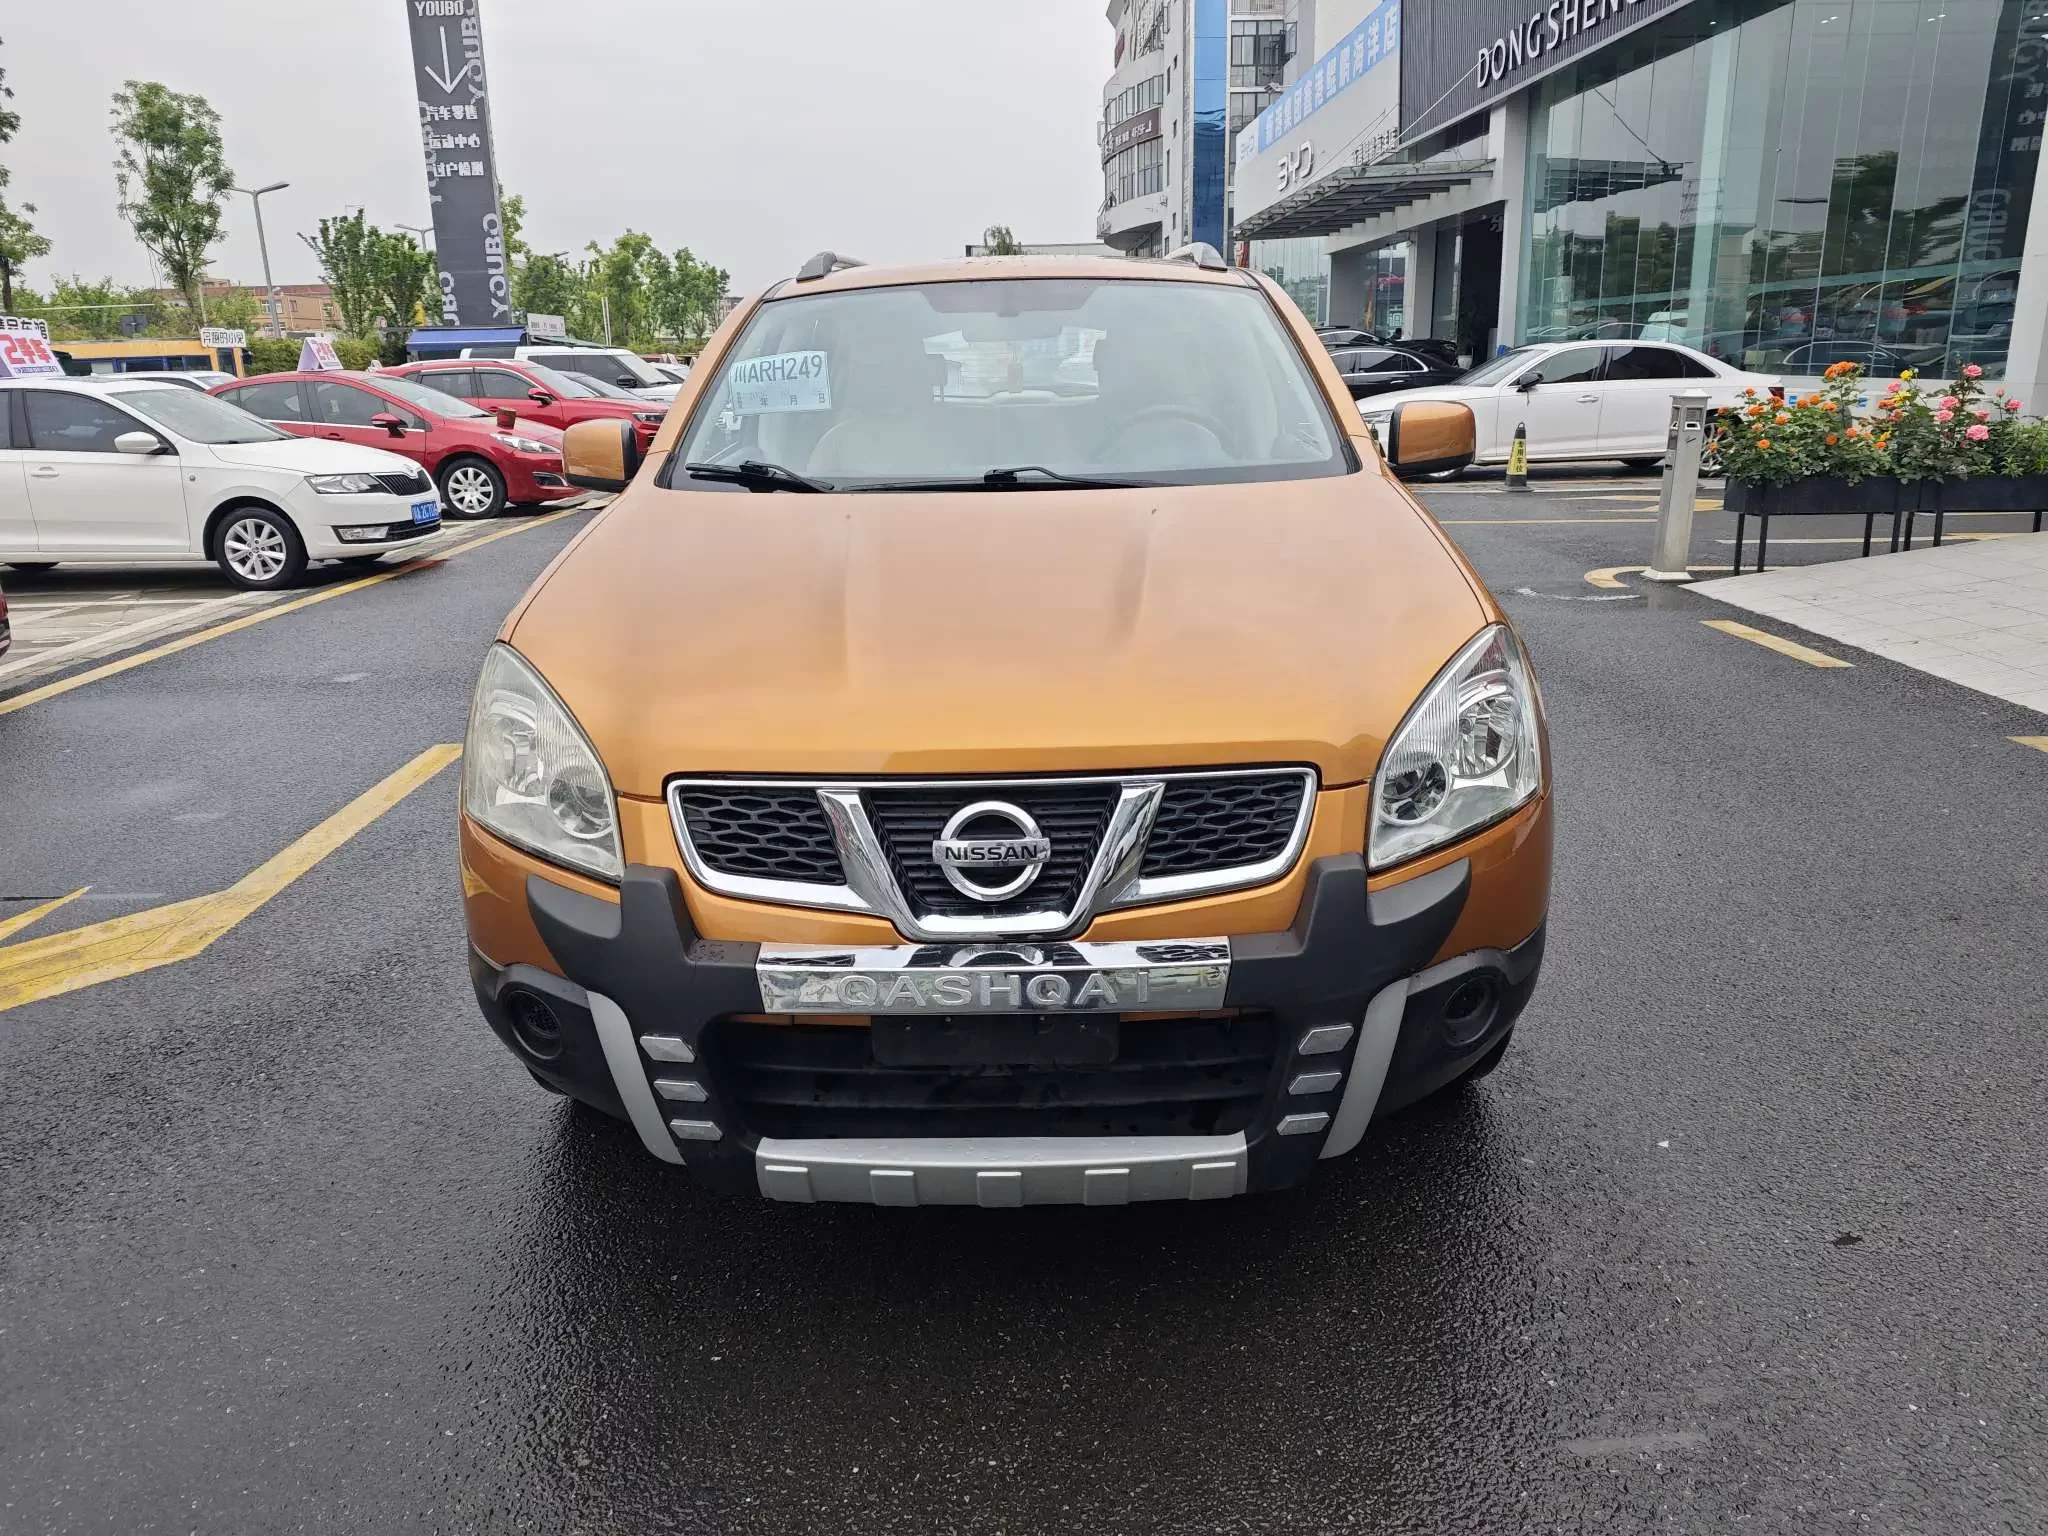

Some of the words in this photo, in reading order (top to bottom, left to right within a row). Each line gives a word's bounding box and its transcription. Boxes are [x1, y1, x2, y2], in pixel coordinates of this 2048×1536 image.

[415, 0, 464, 17] YOUBO
[426, 104, 479, 121] 汽车零售
[429, 132, 481, 149] 运动中心
[482, 212, 509, 319] YOUBO
[734, 354, 823, 384] 川ARH249
[944, 843, 1040, 862] NISSAN
[836, 970, 1151, 1010] QASHQAI
